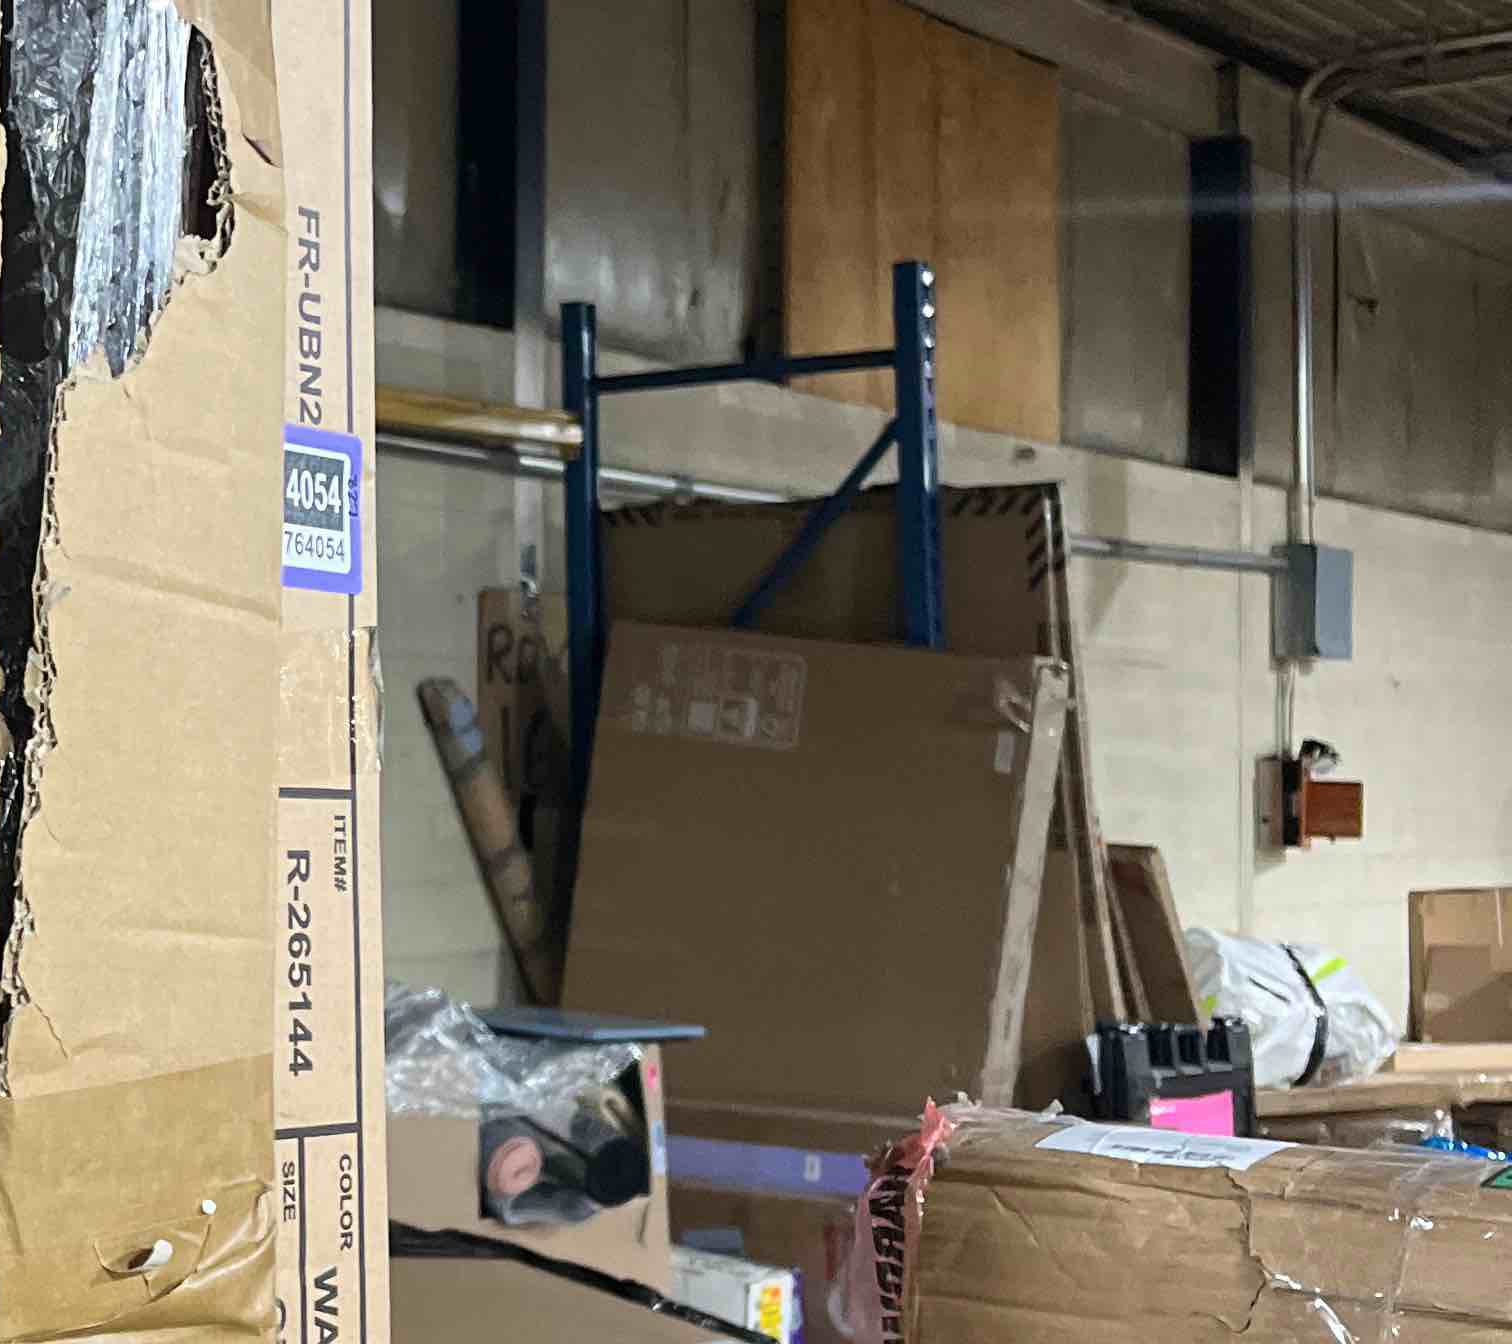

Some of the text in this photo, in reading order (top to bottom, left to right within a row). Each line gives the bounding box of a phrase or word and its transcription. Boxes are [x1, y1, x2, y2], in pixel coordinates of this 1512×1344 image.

[296, 205, 323, 427] FR-UBN2
[286, 467, 342, 514] 4054
[284, 530, 345, 561] 764054
[333, 814, 348, 893] ITEM#
[286, 849, 314, 1078] R-265144
[280, 1159, 297, 1224] SIZE
[338, 1152, 354, 1252] COLOR
